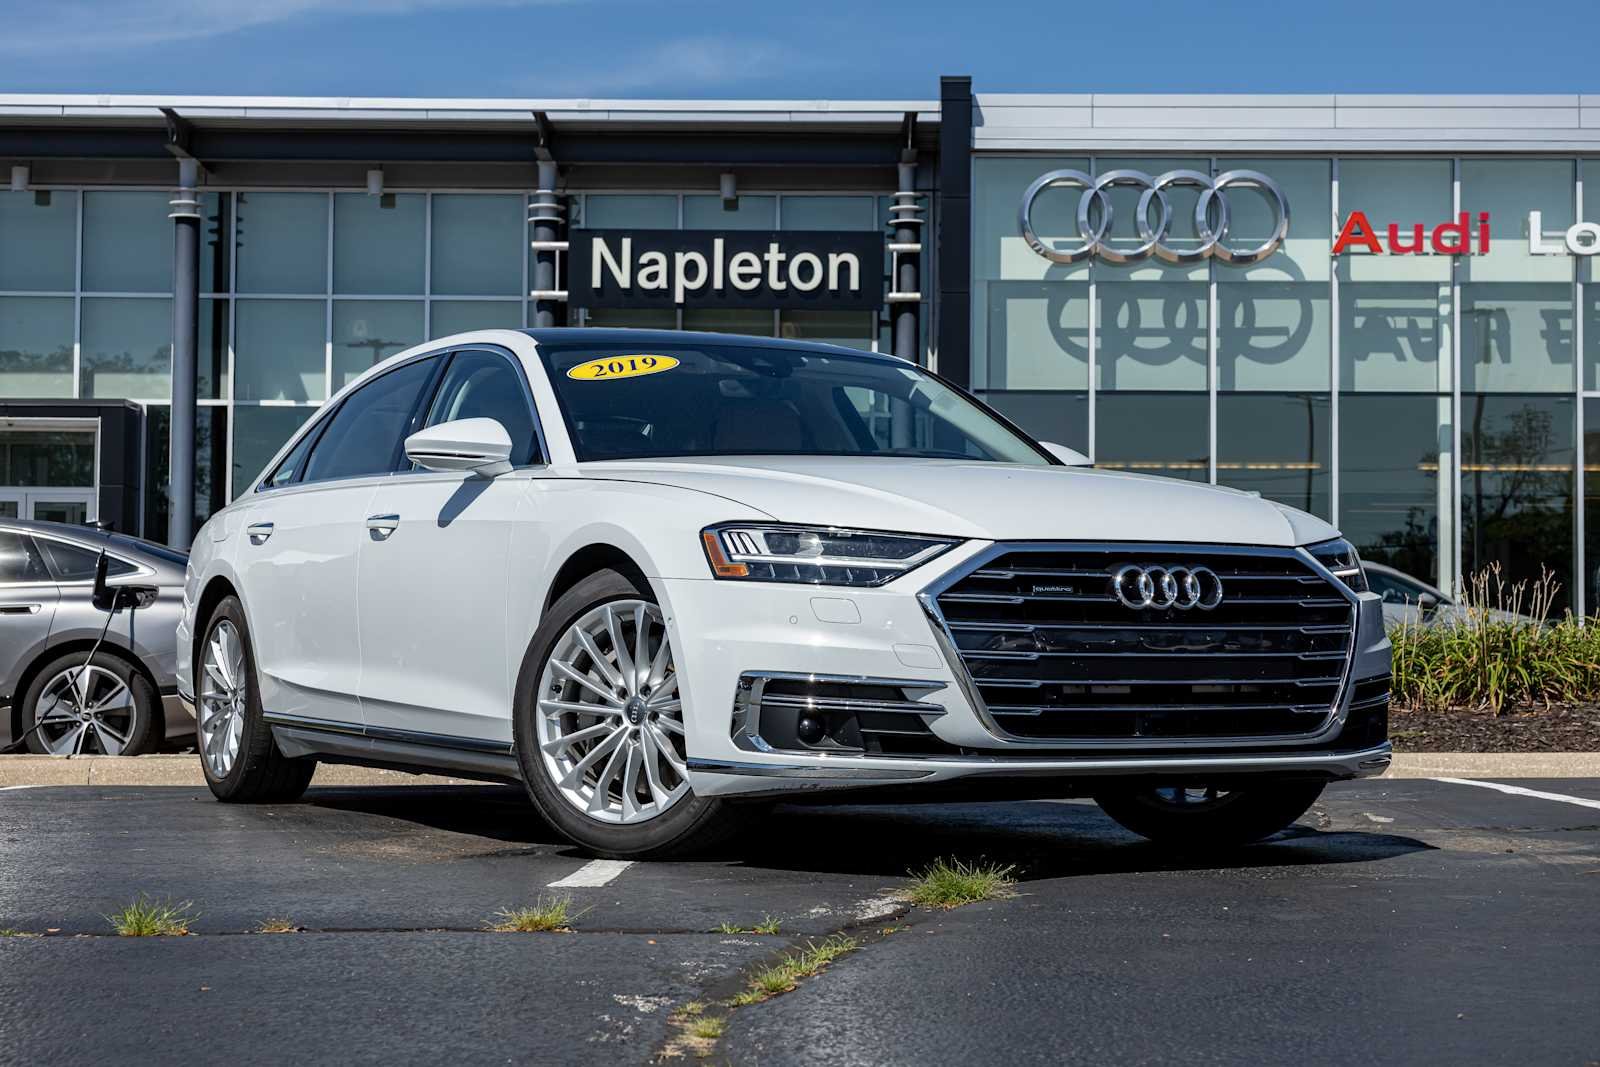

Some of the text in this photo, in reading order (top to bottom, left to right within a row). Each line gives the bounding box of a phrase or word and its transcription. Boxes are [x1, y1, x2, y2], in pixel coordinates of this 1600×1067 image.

[1331, 211, 1490, 254] Audi
[592, 237, 860, 303] Napleton
[591, 357, 657, 377] 2019
